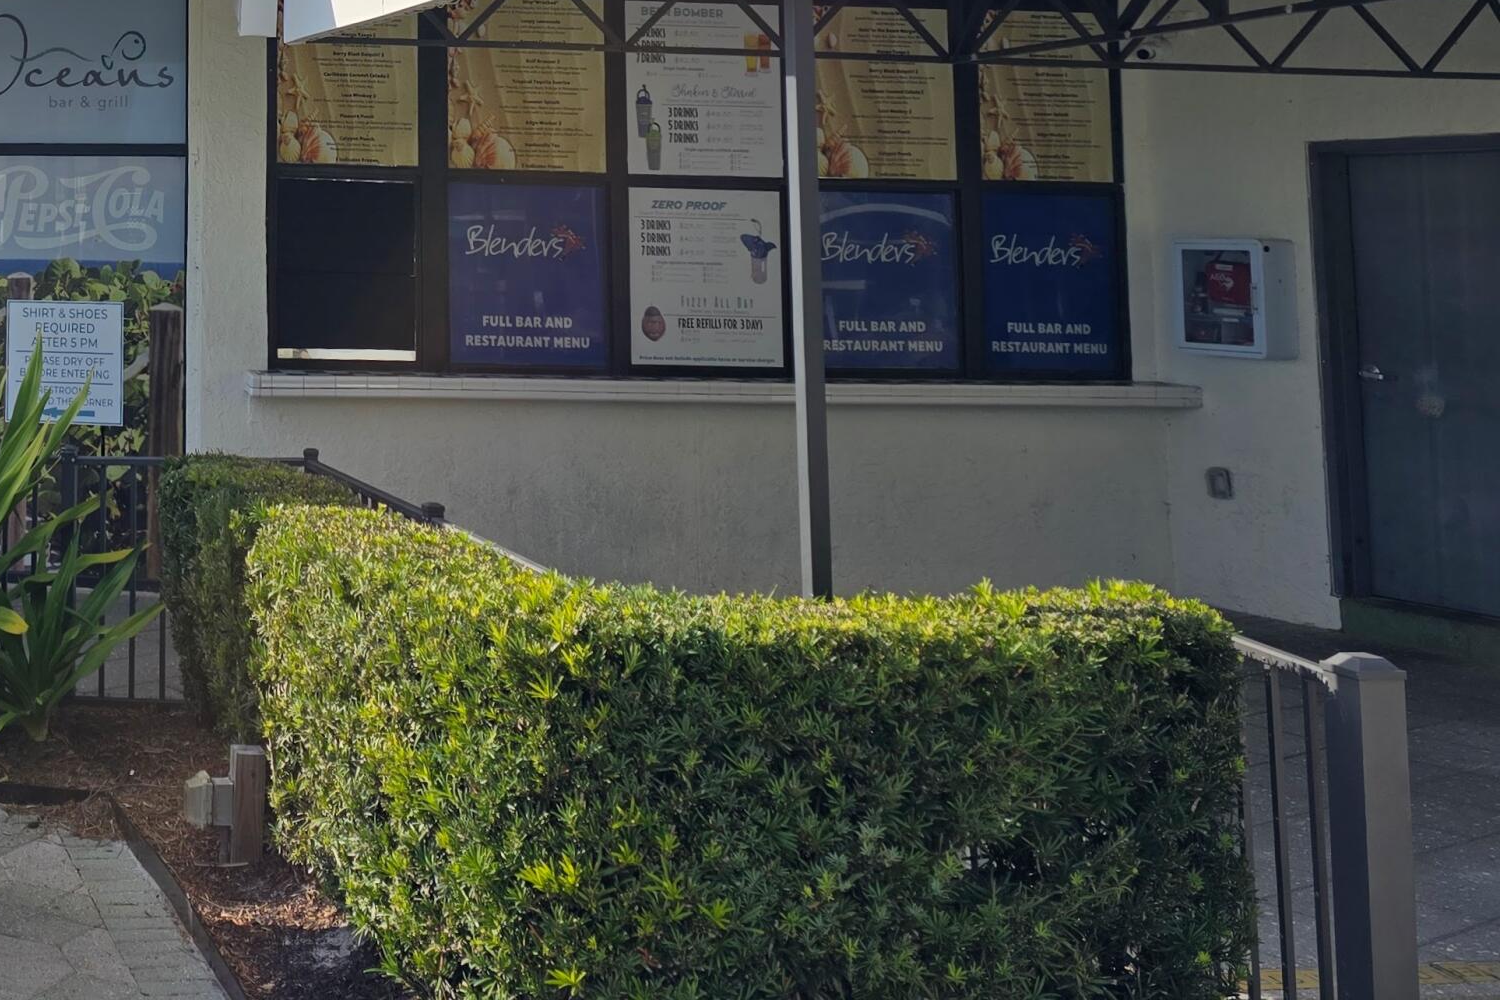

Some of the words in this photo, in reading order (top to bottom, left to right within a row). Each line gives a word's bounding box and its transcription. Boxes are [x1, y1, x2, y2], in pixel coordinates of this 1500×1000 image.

[641, 6, 671, 17] BE
[673, 8, 724, 18] BOMBER
[641, 53, 666, 63] DRINKS
[49, 96, 74, 108] bar
[80, 97, 91, 108] &
[99, 96, 128, 111] grill
[668, 107, 672, 117] 3
[674, 107, 698, 118] DRINKS
[668, 120, 673, 130] 5
[674, 120, 699, 131] DRINKS
[668, 133, 672, 143] 7
[674, 133, 699, 144] DRINKS
[651, 200, 683, 210] ZERO
[684, 201, 728, 211] PROOF
[640, 219, 645, 230] 3
[646, 219, 671, 230] DRINKS
[465, 224, 565, 259] Blenders
[640, 232, 645, 243] 5
[646, 233, 671, 244] DRINKS
[641, 245, 645, 256] 7
[646, 246, 671, 256] DRINKS
[820, 231, 916, 264] Blenders
[989, 233, 1083, 266] Blenders
[22, 307, 56, 318] SHIRT
[58, 308, 66, 319] &
[68, 308, 108, 320] SHOES
[35, 321, 95, 334] REQUIRED
[482, 315, 513, 327] FULL
[515, 316, 543, 328] BAR
[544, 317, 573, 329] AND
[678, 318, 694, 329] FREE
[696, 318, 722, 329] REFILLS
[723, 319, 738, 330] FOR
[740, 319, 745, 330] 3
[746, 320, 763, 331] DAYS
[839, 320, 868, 332] FULL
[870, 321, 896, 332] BAR
[899, 321, 926, 333] AND
[1007, 322, 1035, 334] FULL
[1037, 322, 1063, 334] BAR
[1065, 323, 1092, 335] AND
[71, 337, 77, 348] 5
[80, 338, 98, 348] PM
[465, 335, 550, 347] RESTAURANT
[553, 337, 590, 348] MENU
[823, 339, 904, 351] RESTAURANT
[908, 340, 943, 352] MENU
[991, 341, 1071, 353] RESTAURANT
[1073, 343, 1108, 354] MENU
[25, 355, 60, 366] PASE
[63, 356, 83, 366] DRY
[85, 357, 104, 367] OFF
[20, 367, 58, 378] BORE
[61, 368, 109, 380] ENTERING
